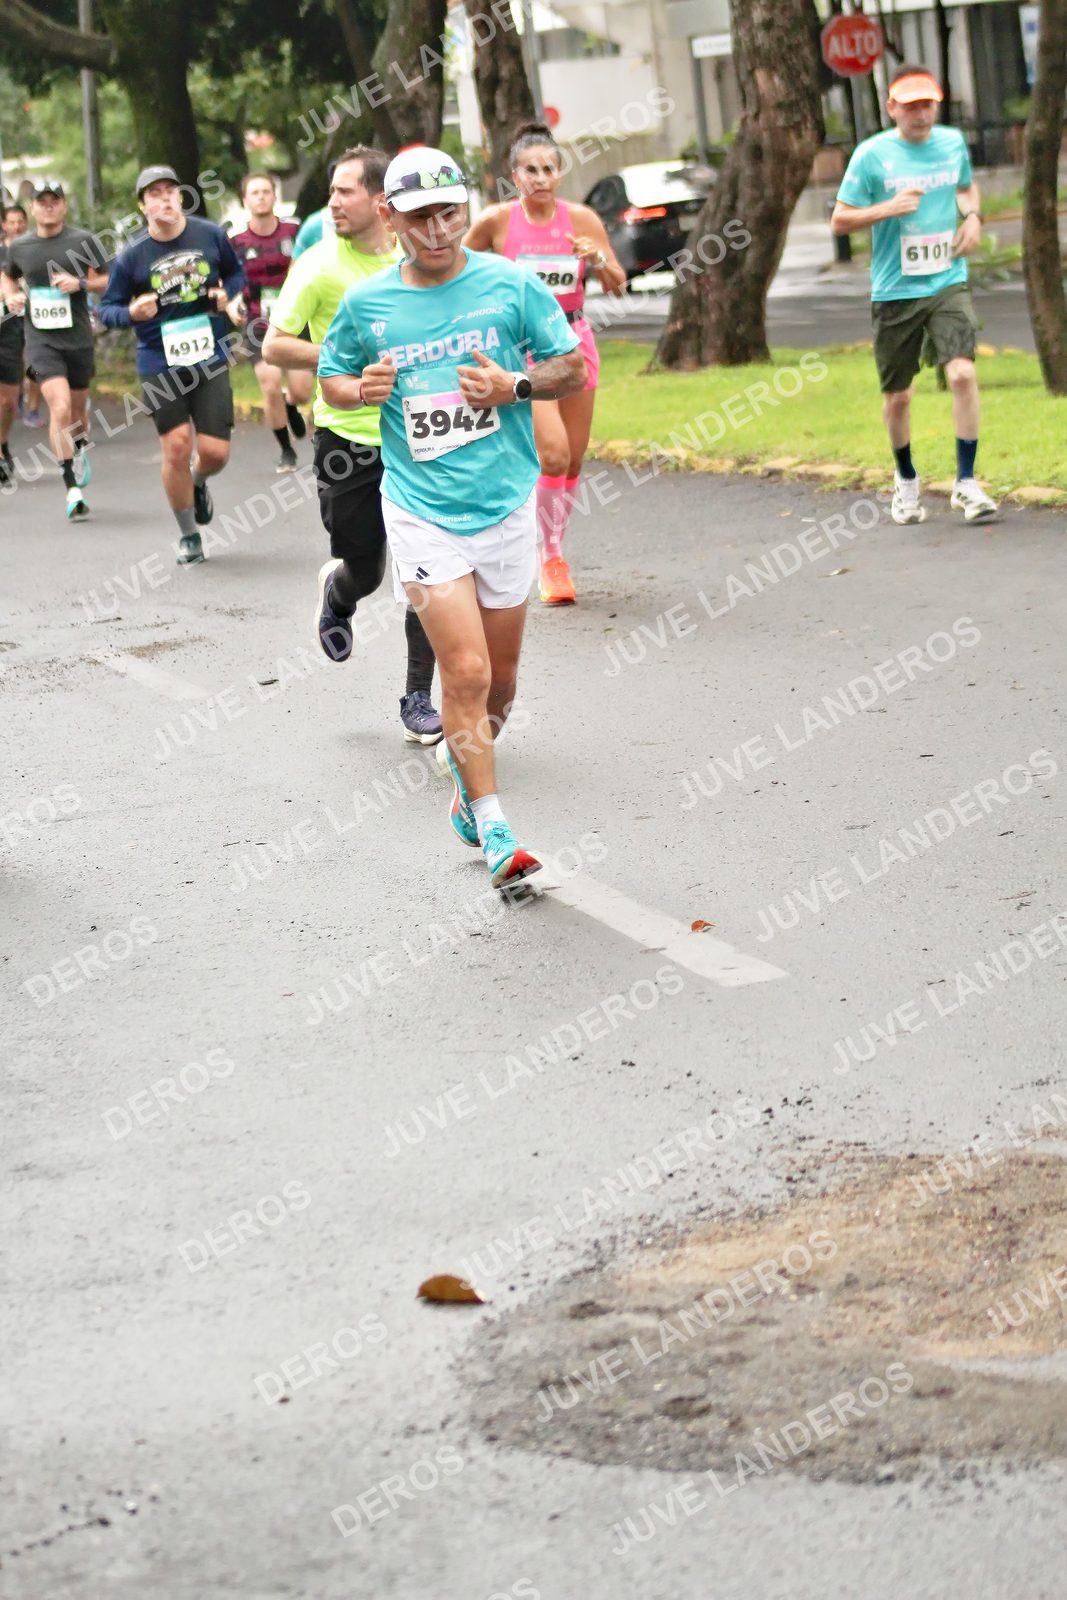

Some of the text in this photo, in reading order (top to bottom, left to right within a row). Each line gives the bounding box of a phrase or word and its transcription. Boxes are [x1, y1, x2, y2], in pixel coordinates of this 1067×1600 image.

[829, 31, 878, 59] ALTO
[906, 242, 949, 261] 6101
[34, 307, 67, 319] 3069
[466, 306, 505, 319] BROOKS
[169, 336, 211, 357] 4912
[410, 405, 495, 440] 3942
